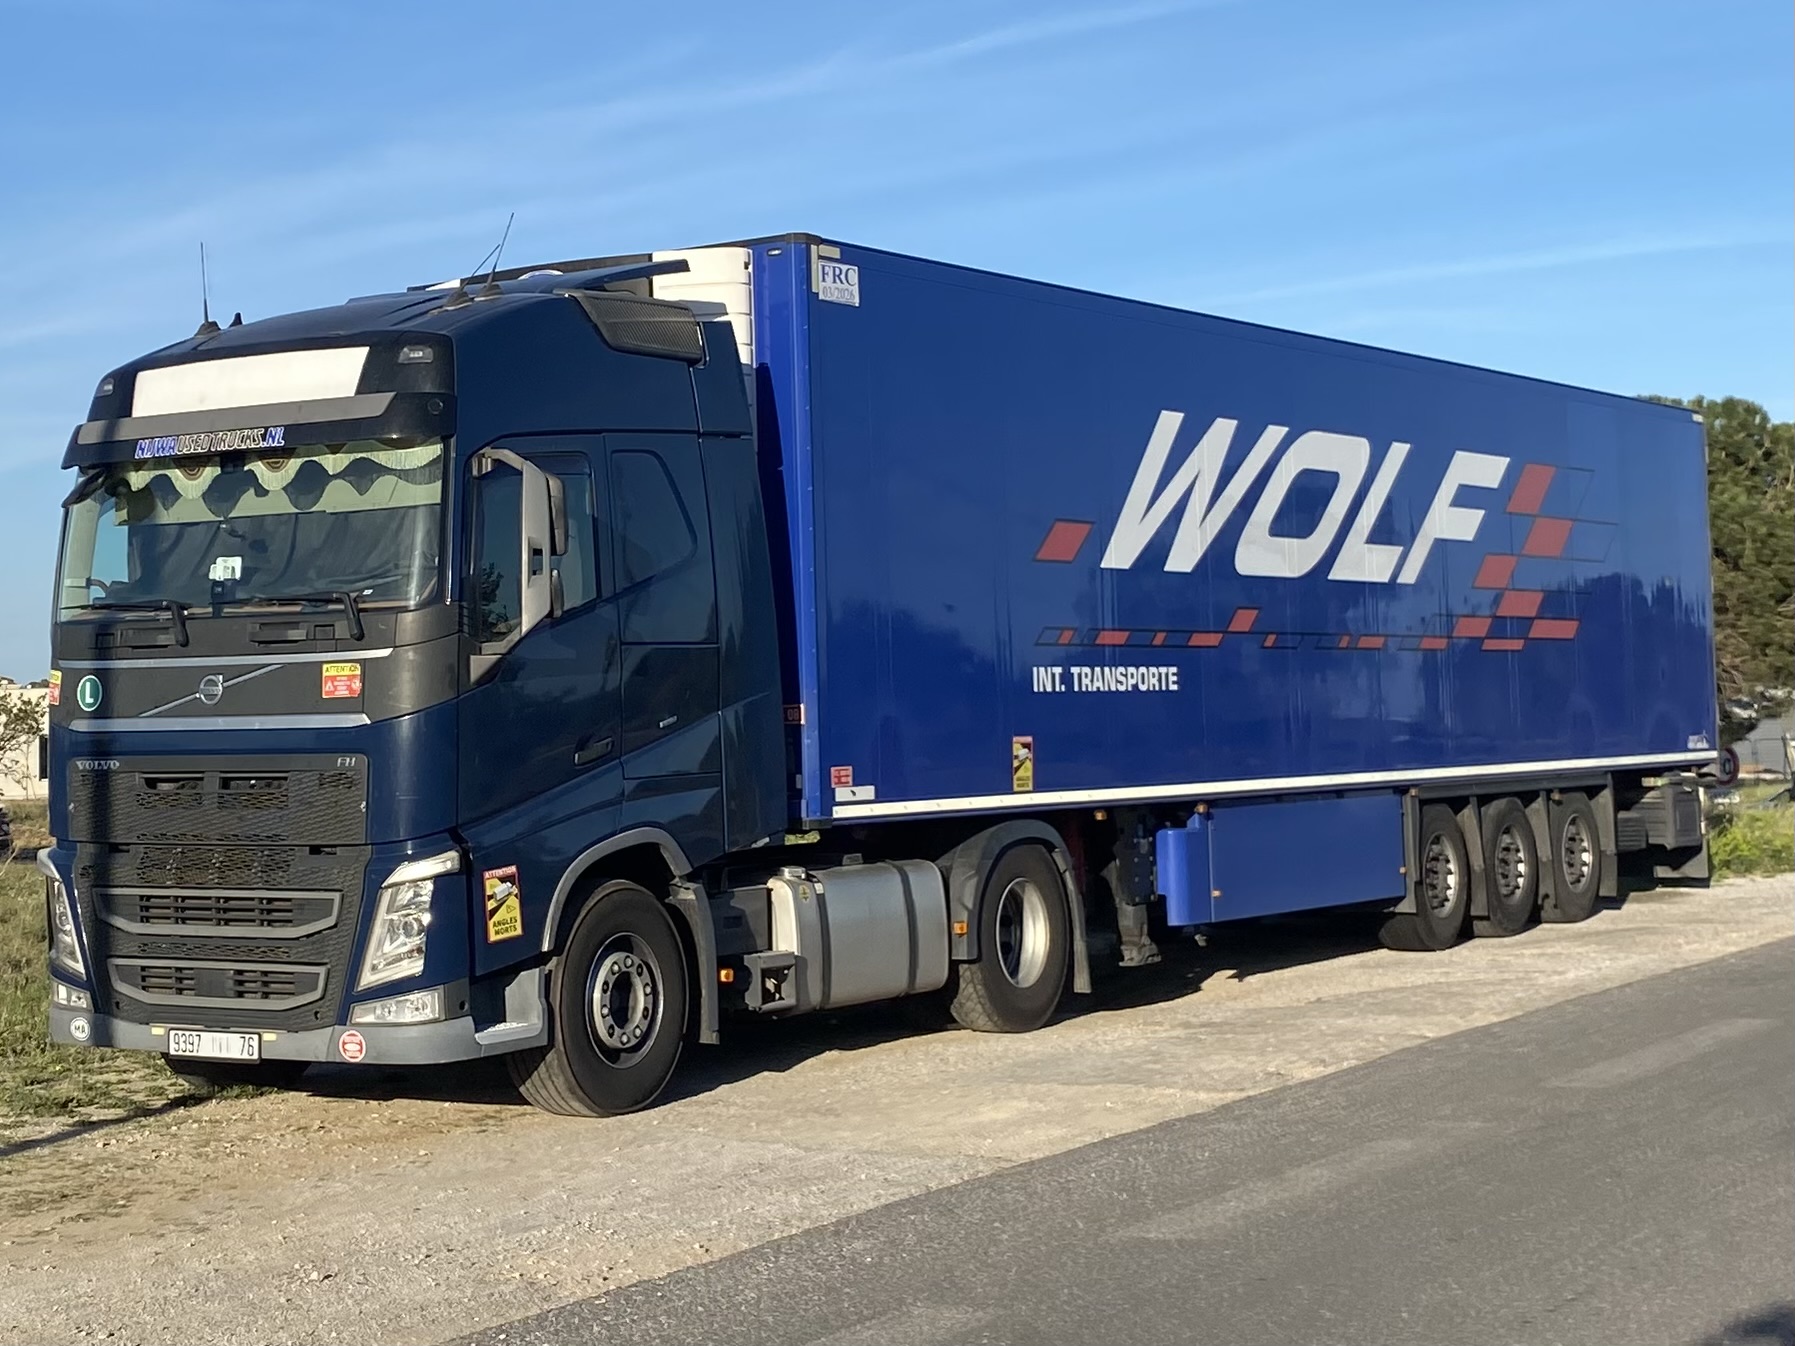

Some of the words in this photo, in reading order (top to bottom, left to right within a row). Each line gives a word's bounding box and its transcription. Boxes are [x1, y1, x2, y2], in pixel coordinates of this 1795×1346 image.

[820, 264, 857, 287] FRC
[822, 286, 856, 301] 03/2026
[1100, 410, 1510, 584] WOLF
[1032, 666, 1066, 692] INT.
[1070, 666, 1179, 692] TRANSPORTE
[85, 681, 95, 704] L
[75, 760, 120, 770] VOLVO
[492, 916, 518, 929] ANGLES
[494, 924, 518, 936] MORTS
[74, 1024, 87, 1035] MA
[173, 1033, 201, 1053] 9397
[239, 1036, 255, 1056] 76
